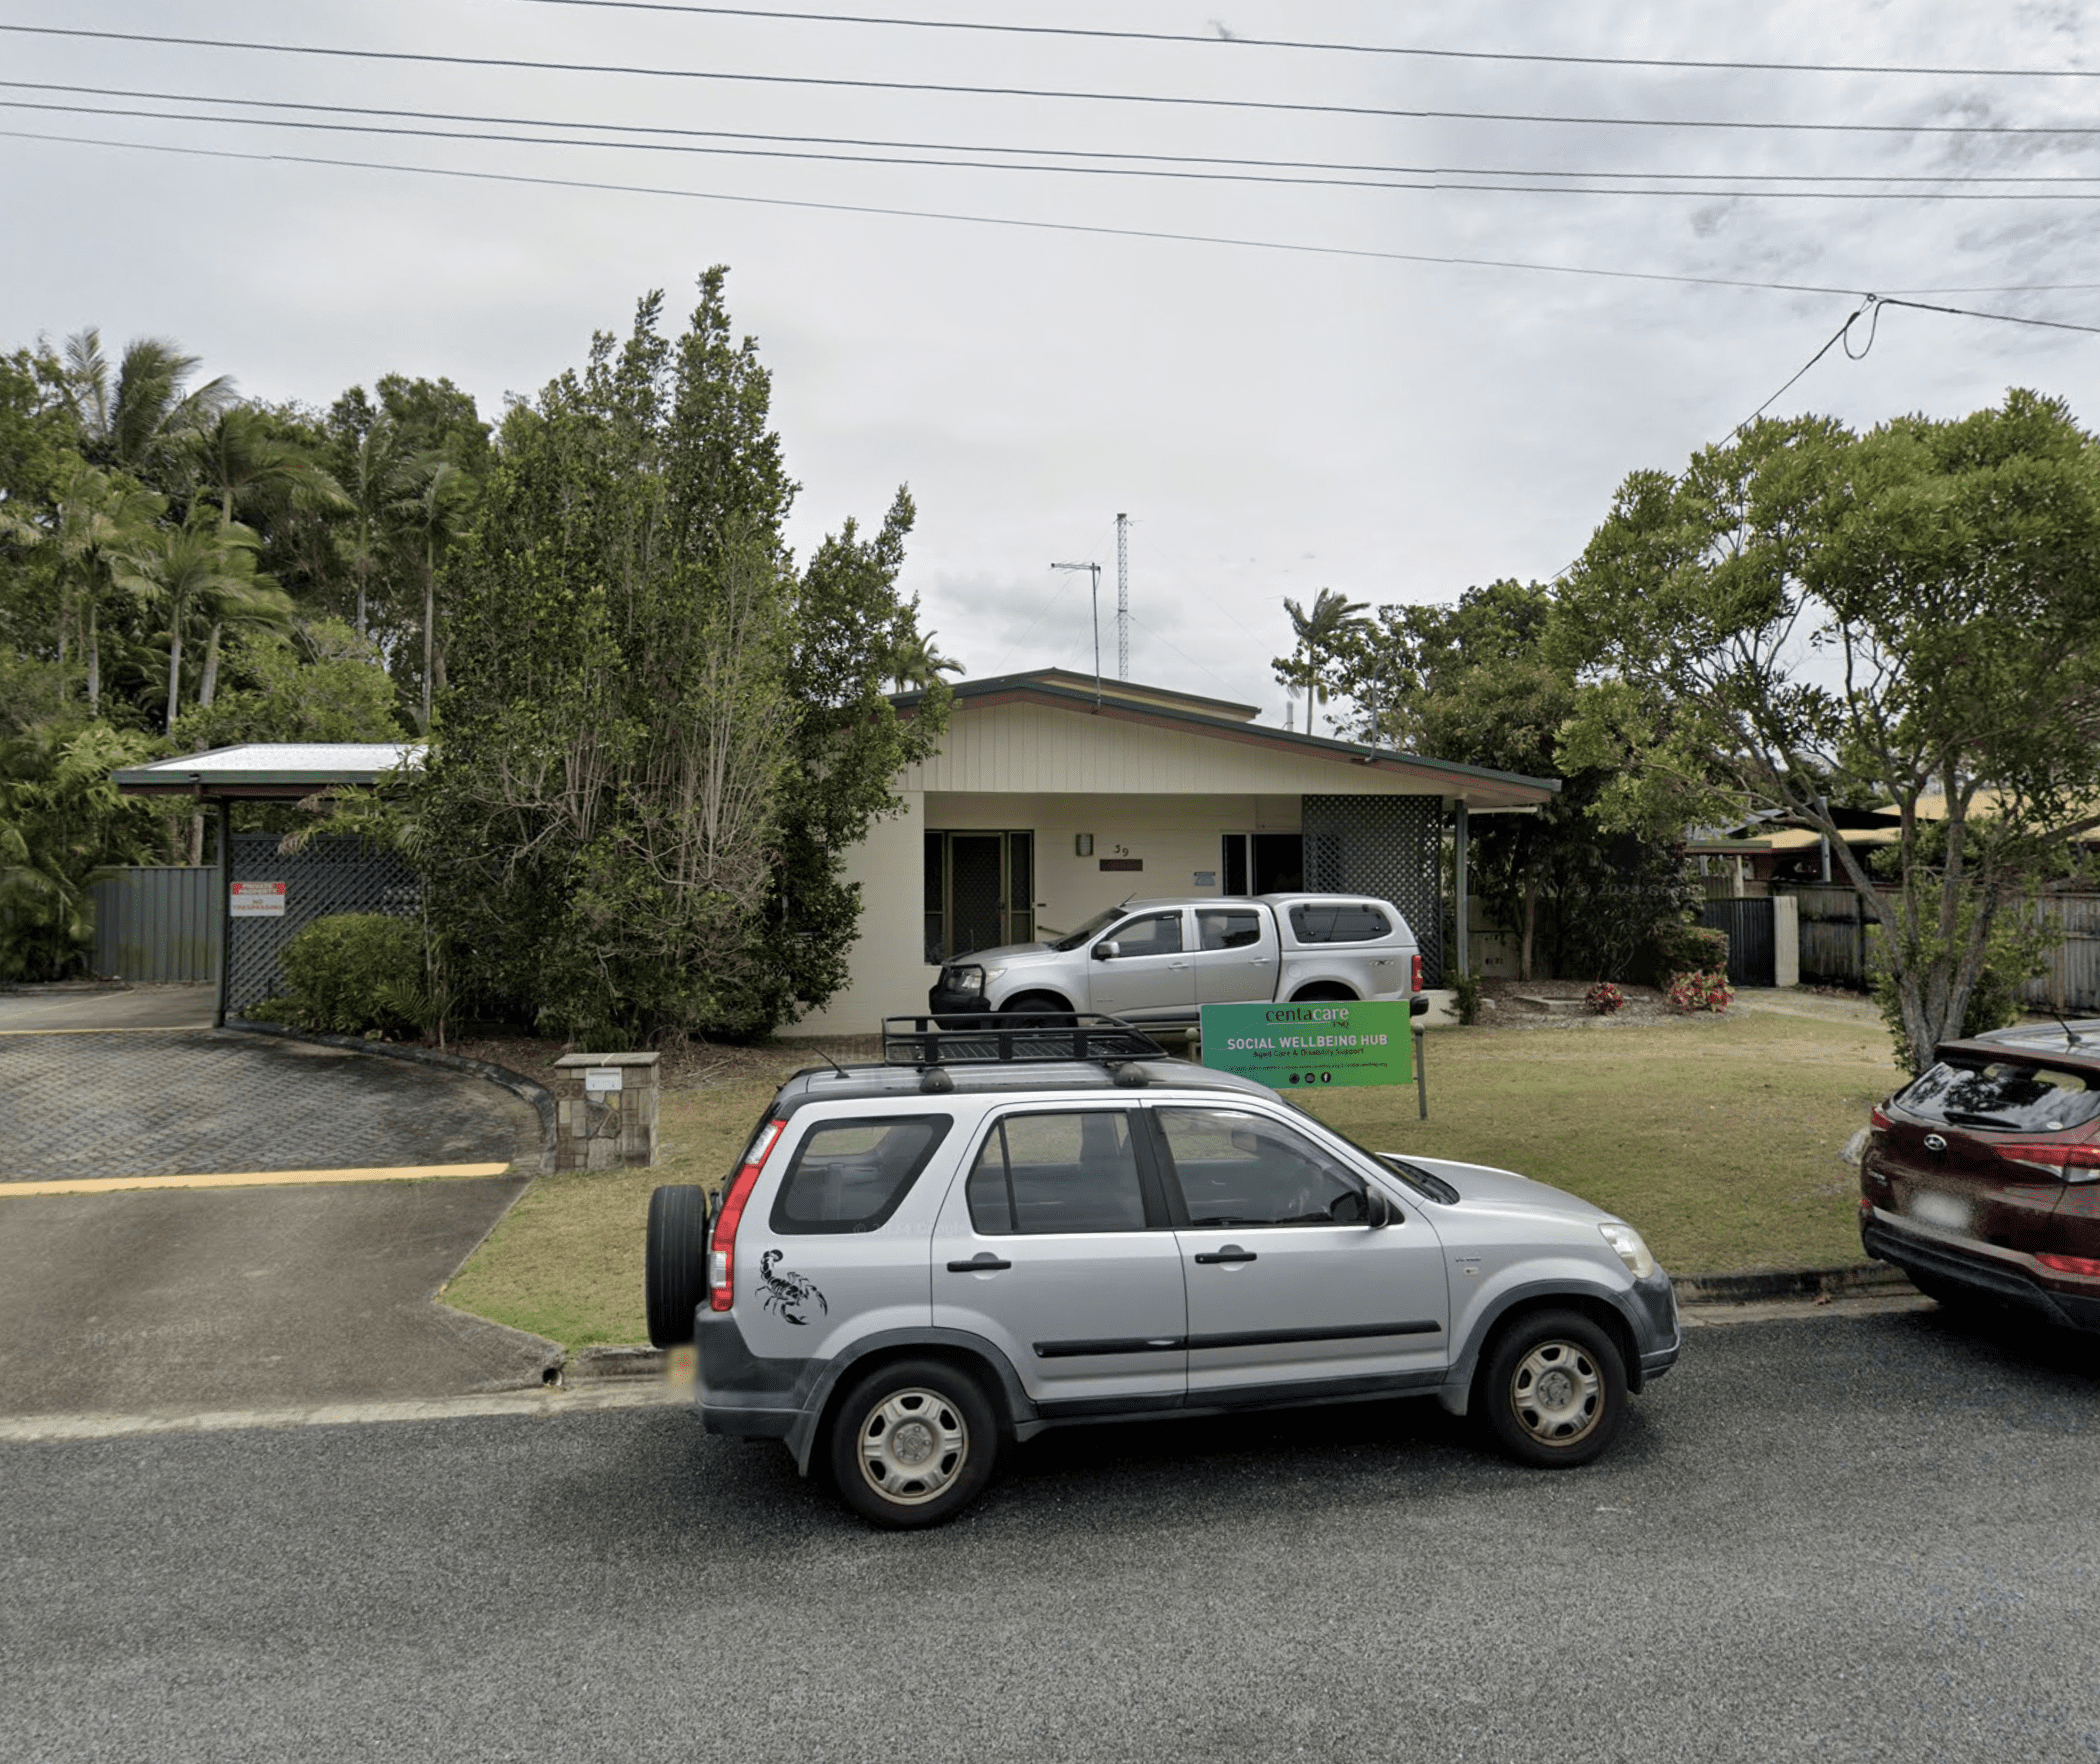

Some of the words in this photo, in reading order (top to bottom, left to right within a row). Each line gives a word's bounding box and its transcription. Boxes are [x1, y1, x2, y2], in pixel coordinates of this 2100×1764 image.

[1113, 844, 1129, 857] 39
[1266, 1007, 1350, 1022] centacare
[1227, 1037, 1276, 1050] SOCIAL
[1279, 1035, 1357, 1048] WELLBEING
[1361, 1034, 1388, 1046] HUB
